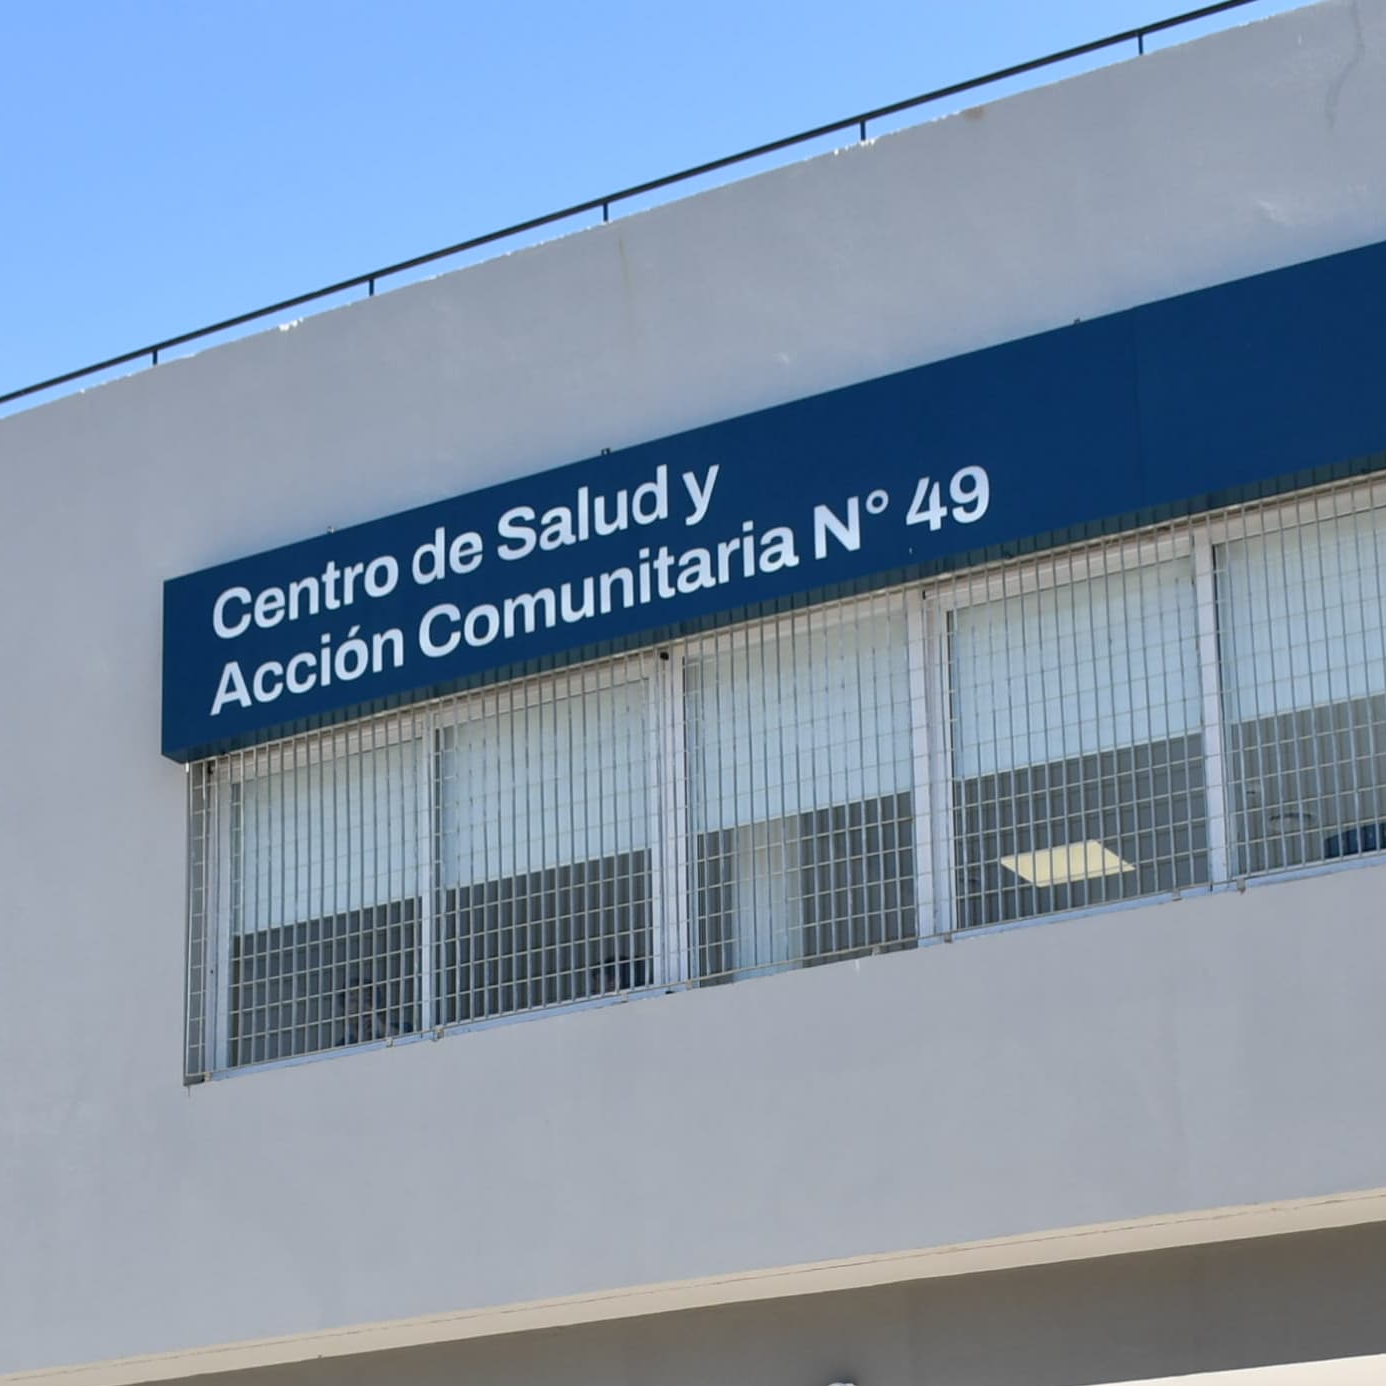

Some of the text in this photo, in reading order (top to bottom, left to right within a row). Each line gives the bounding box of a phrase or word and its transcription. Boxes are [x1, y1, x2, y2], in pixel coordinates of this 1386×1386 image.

[210, 625, 404, 716] Acción
[419, 520, 800, 657] Comunitaria
[906, 466, 990, 531] 49
[213, 464, 719, 639] Centro de Salud y
